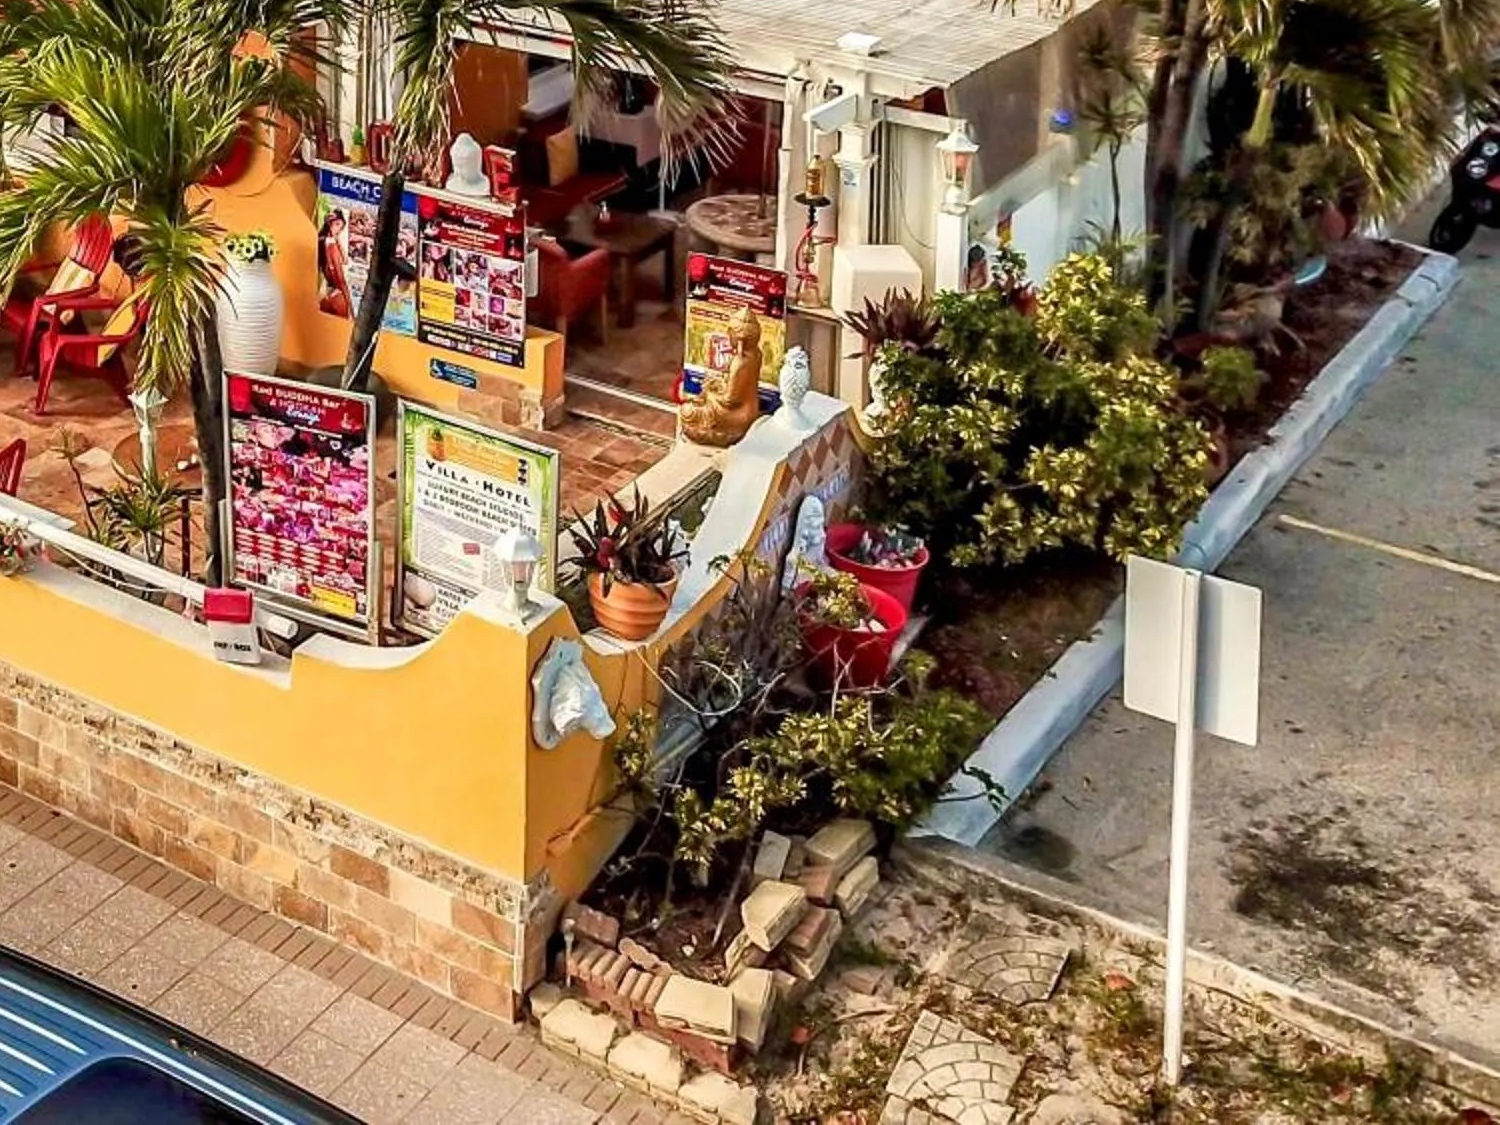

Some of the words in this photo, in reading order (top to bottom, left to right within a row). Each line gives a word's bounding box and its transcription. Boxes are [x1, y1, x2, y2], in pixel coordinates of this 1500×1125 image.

[332, 176, 370, 194] BEACH
[252, 384, 272, 396] Red
[275, 388, 320, 405] BUDDHA
[322, 398, 341, 409] Bar
[426, 459, 469, 484] VILLA
[483, 480, 531, 507] HOTEL
